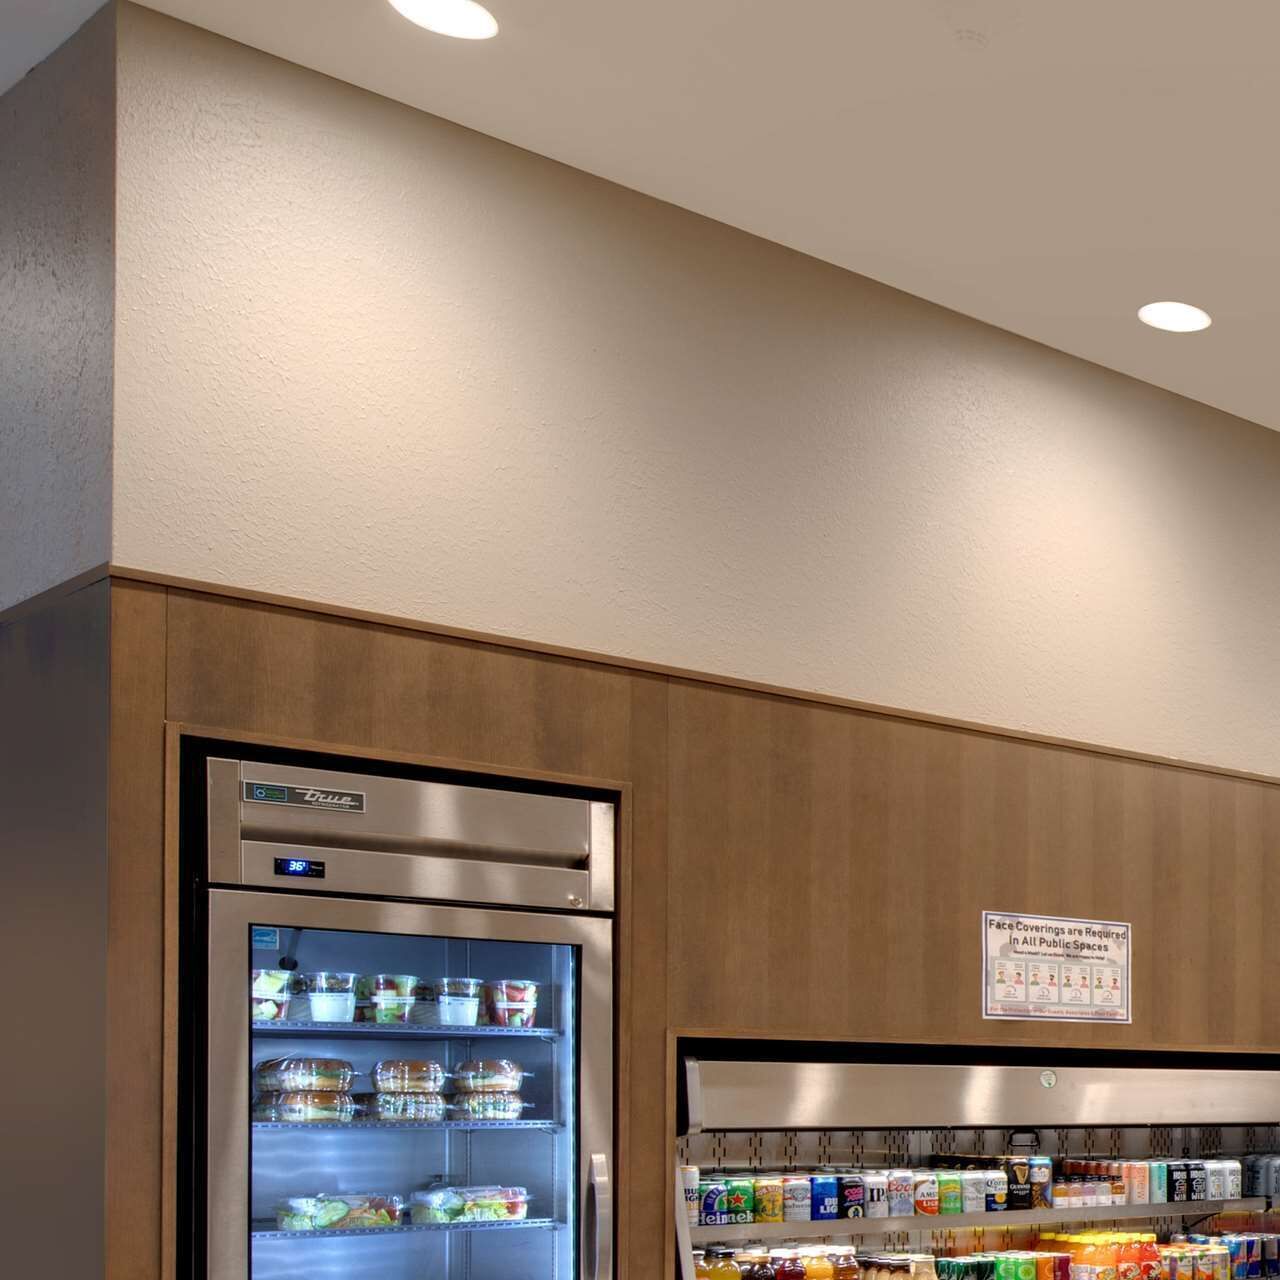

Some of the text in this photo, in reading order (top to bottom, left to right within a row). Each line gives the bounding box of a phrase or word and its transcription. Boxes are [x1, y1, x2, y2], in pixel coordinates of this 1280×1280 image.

[988, 919, 1127, 940] Face Coverings are Required
[1009, 935, 1109, 952] In All Public Spaces
